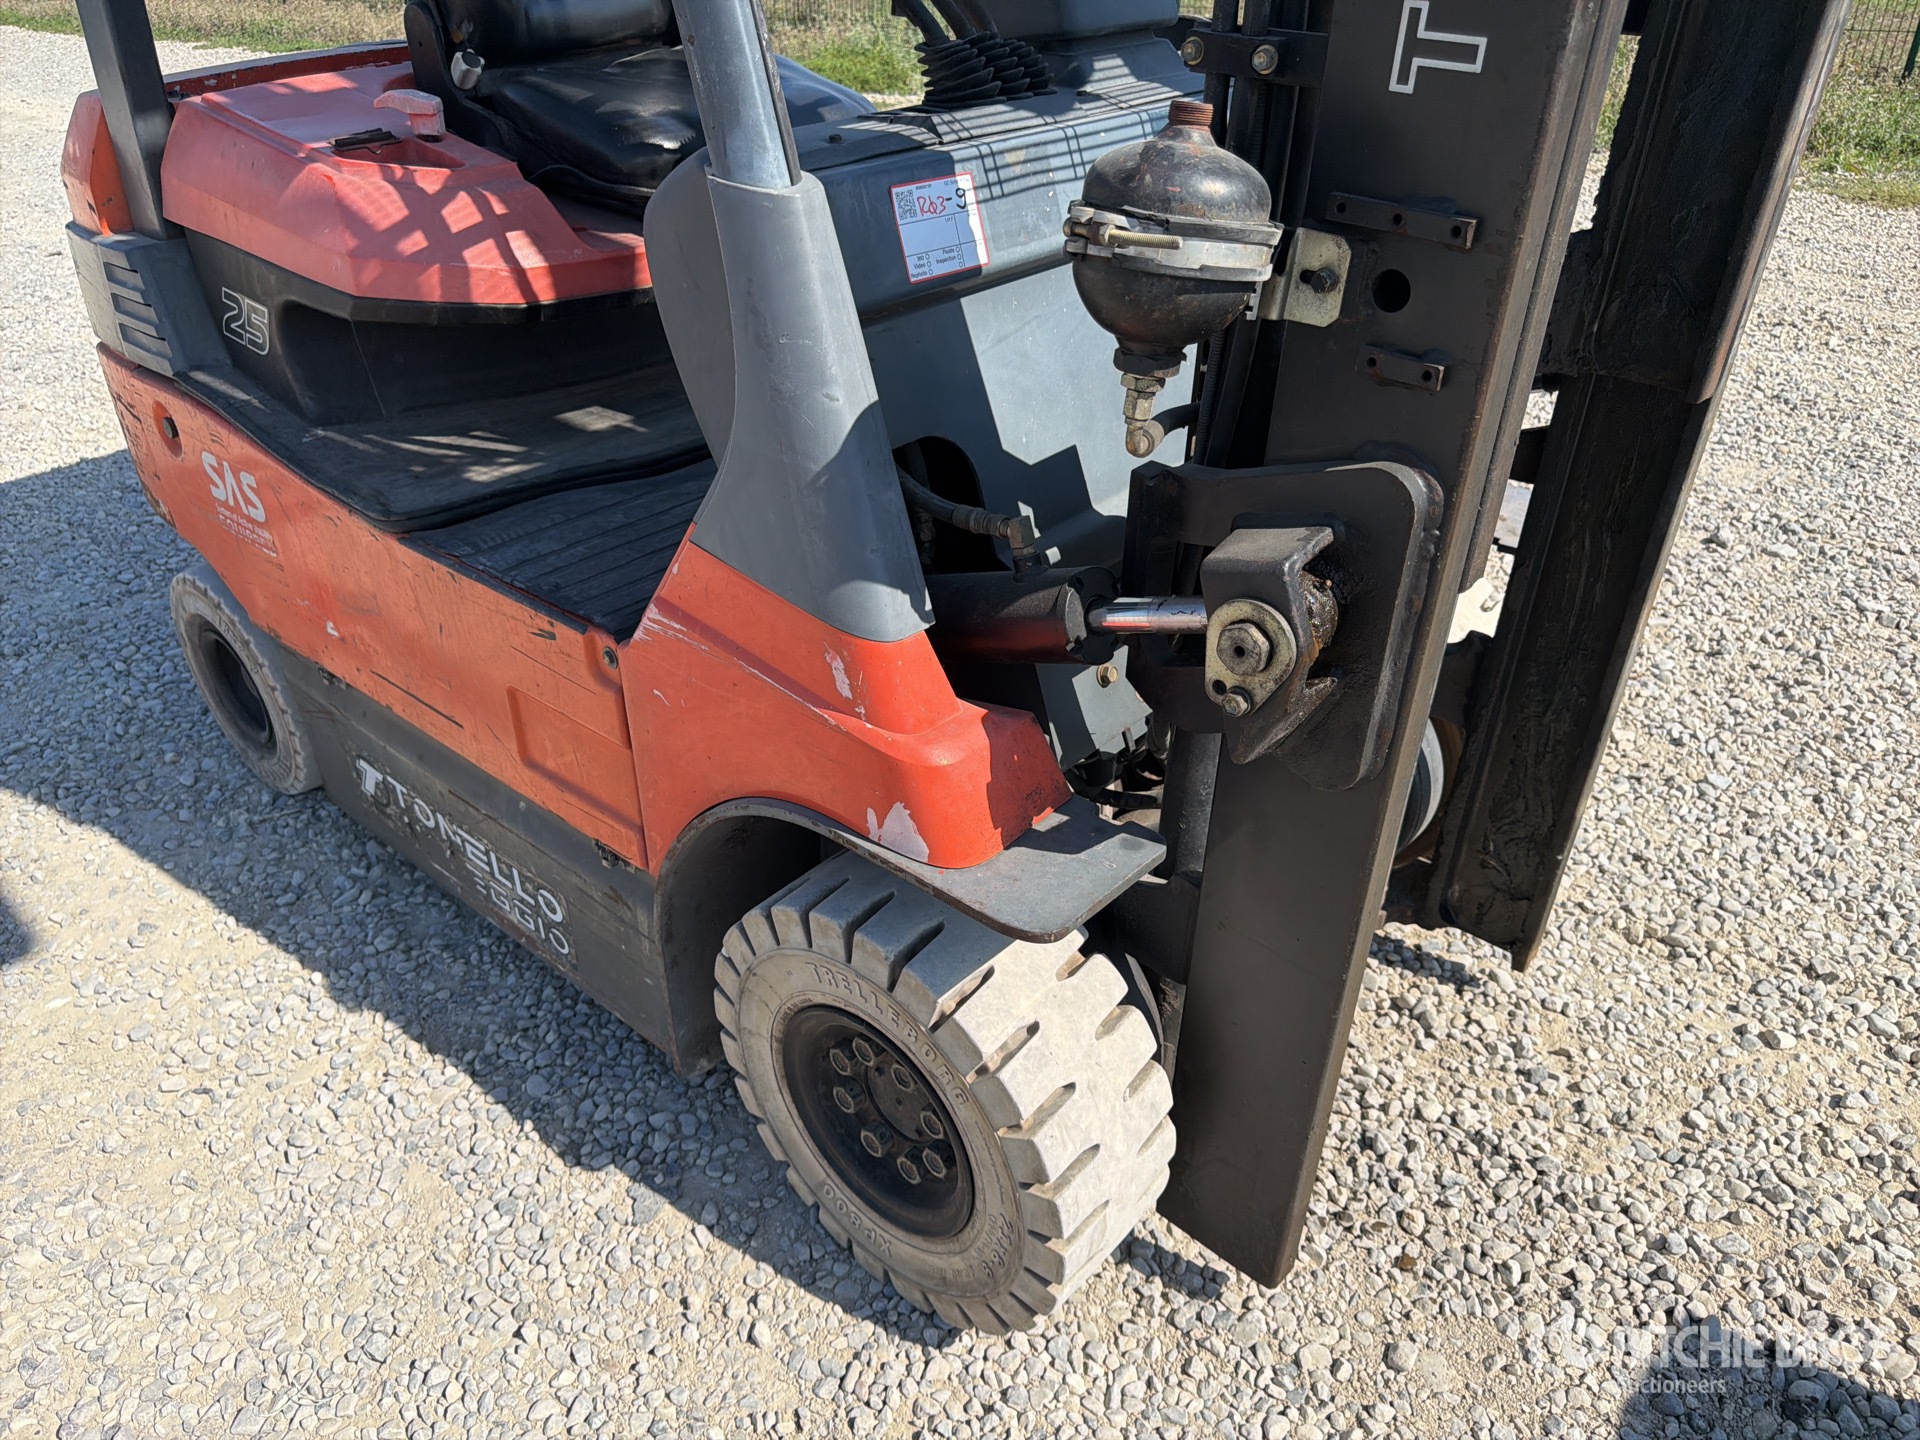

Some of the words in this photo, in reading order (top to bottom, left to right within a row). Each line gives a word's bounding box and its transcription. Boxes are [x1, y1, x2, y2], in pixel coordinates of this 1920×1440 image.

[1388, 0, 1488, 94] T
[936, 256, 957, 265] Inspection
[221, 286, 270, 356] 25
[202, 451, 266, 523] SAS
[387, 774, 564, 923] TONELLO
[805, 961, 970, 1105] TRELLEBORG
